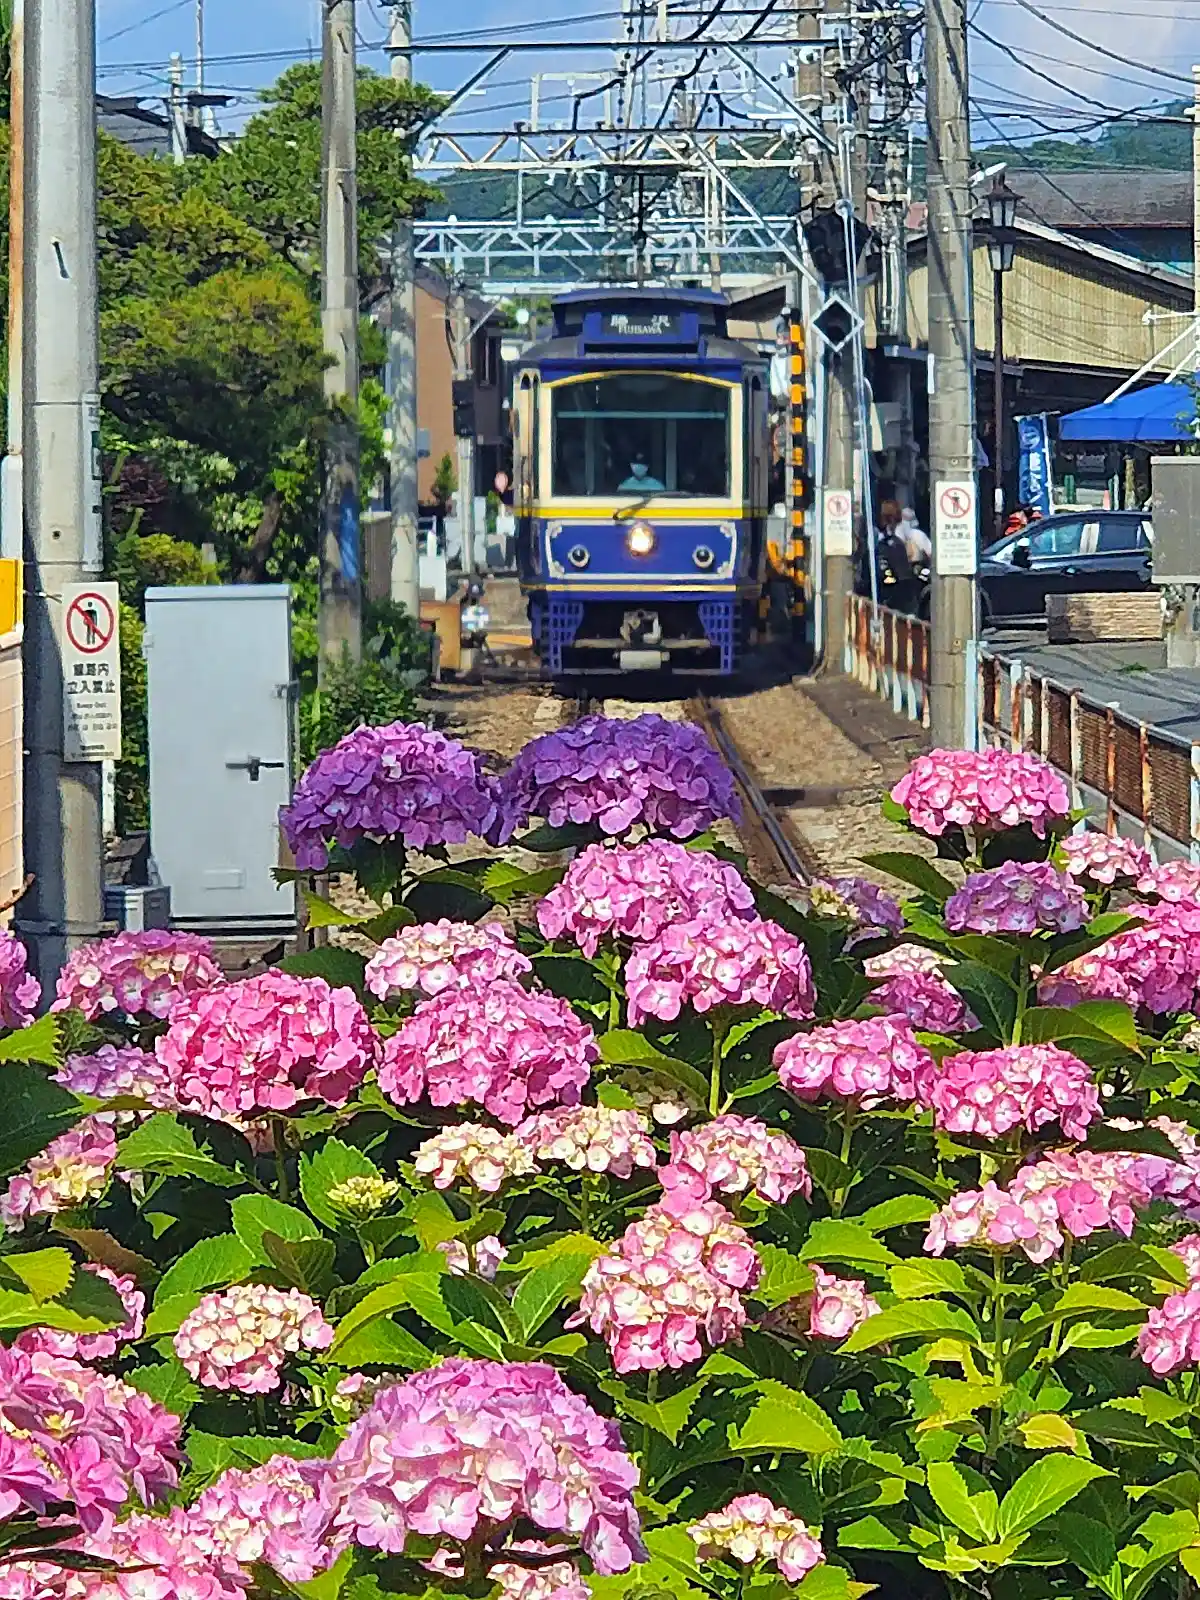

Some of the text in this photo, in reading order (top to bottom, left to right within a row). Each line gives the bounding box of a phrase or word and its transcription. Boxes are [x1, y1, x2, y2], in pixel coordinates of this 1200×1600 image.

[618, 325, 663, 335] FUJISAWA
[67, 680, 116, 695] 立入禁止
